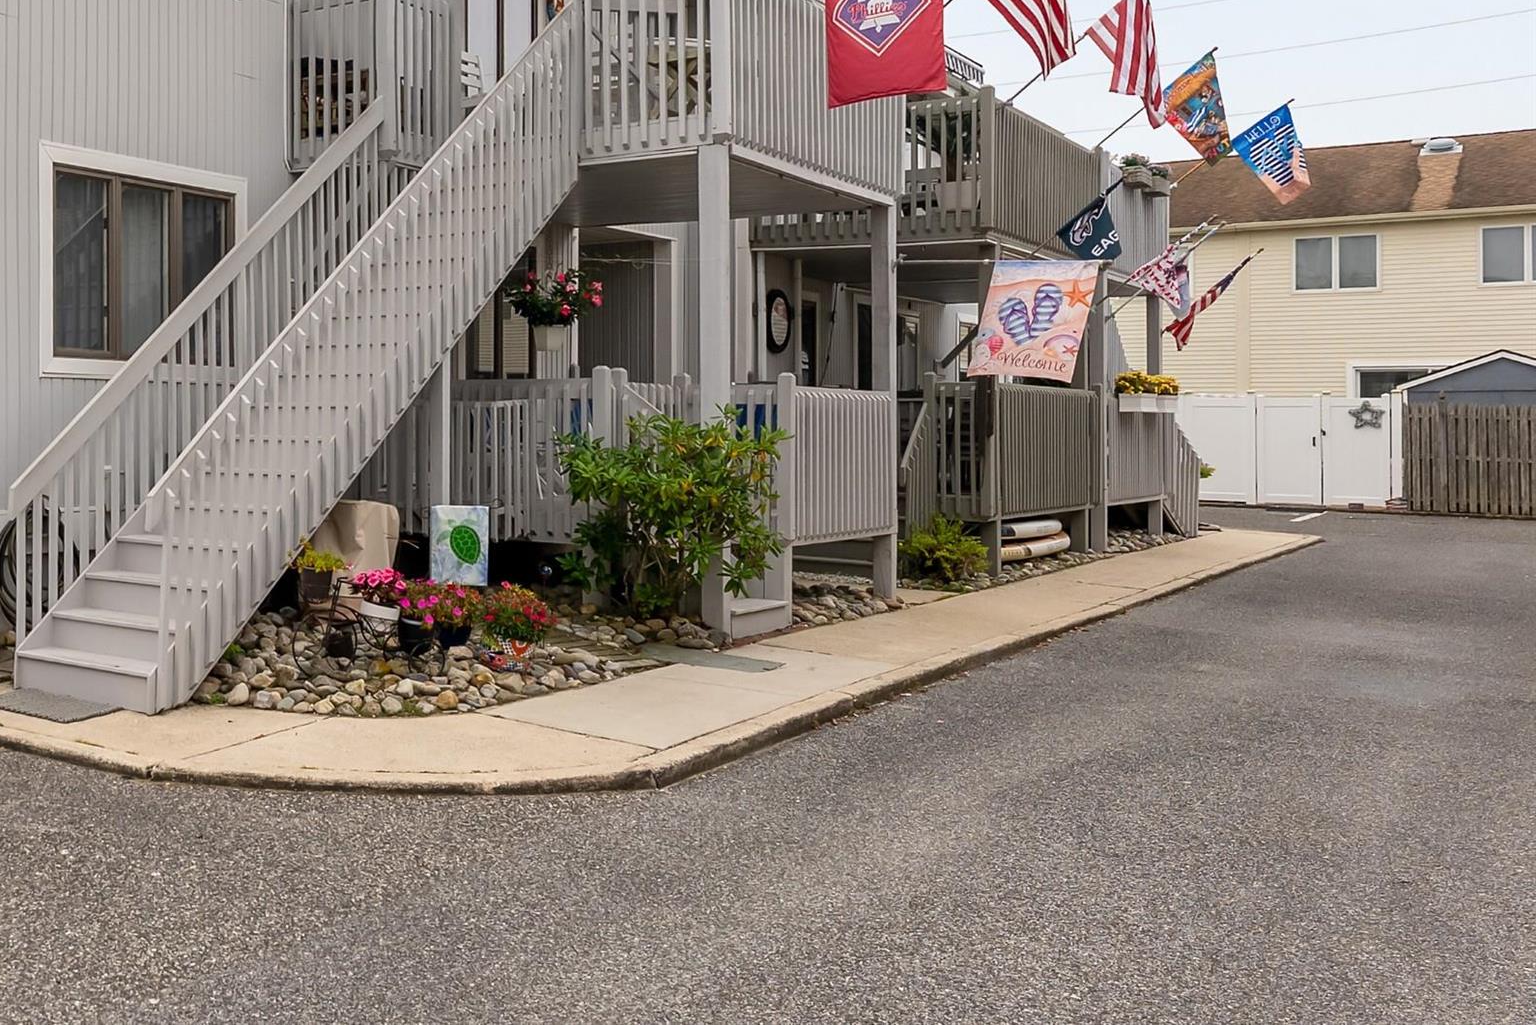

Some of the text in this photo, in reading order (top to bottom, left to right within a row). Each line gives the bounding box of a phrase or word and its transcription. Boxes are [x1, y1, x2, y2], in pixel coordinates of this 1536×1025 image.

[848, 1, 907, 24] Phillies
[1244, 115, 1282, 144] HELLO
[996, 348, 1068, 374] Welcome
